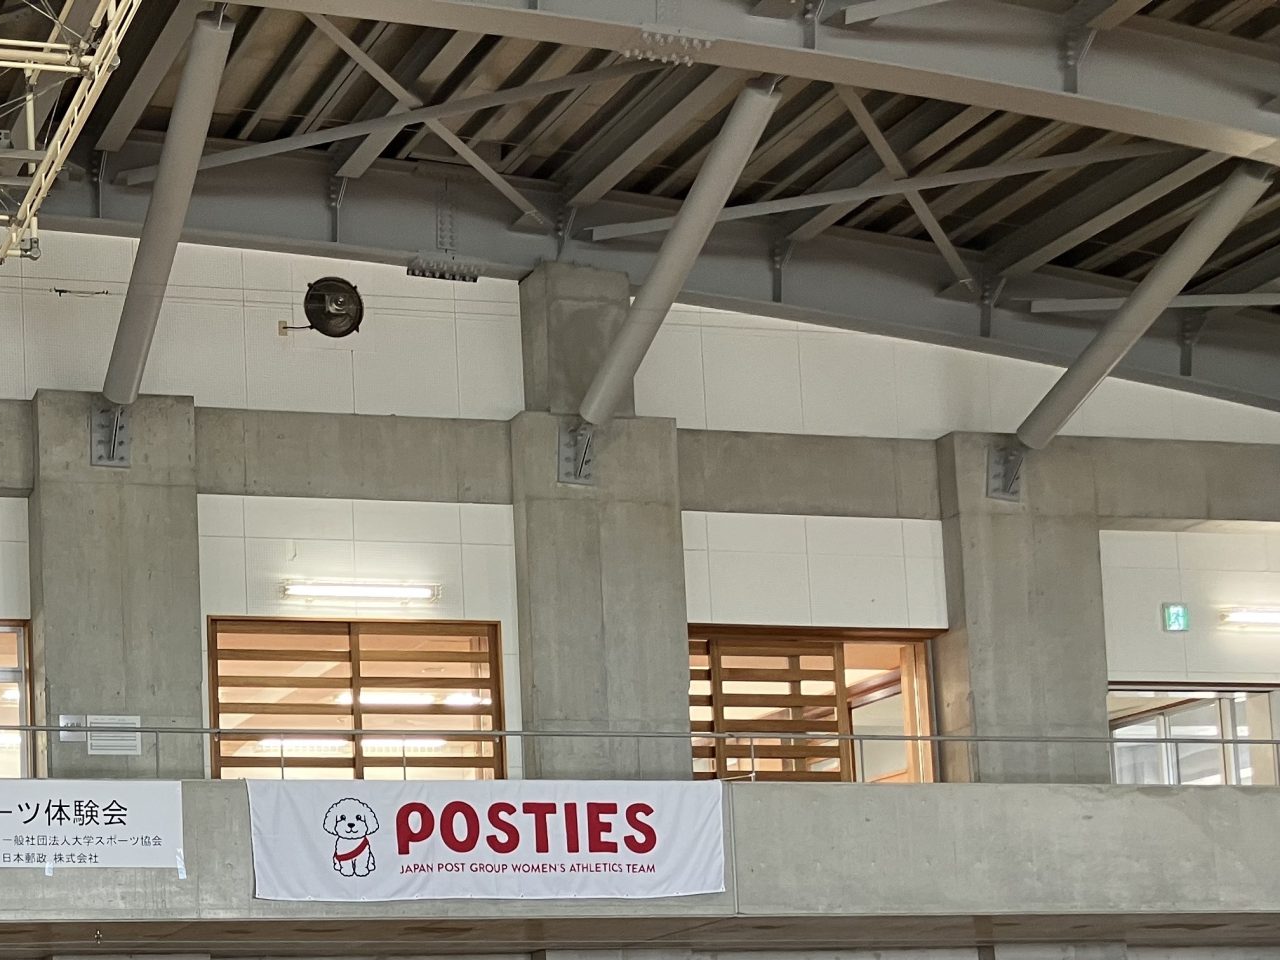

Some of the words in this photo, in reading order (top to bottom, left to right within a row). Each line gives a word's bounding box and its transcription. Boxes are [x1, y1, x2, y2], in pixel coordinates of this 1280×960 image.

[395, 800, 657, 855] POSTIES
[2, 834, 163, 847] 一般社団法人大学スポーツ協会
[2, 852, 47, 864] 日本郵政
[53, 852, 99, 864] 株式会社
[399, 863, 434, 875] JAPAN
[437, 863, 466, 873] POST
[469, 862, 508, 874] GROUP
[511, 862, 566, 874] WOMEN'S
[569, 862, 623, 874] ATHLETICS
[625, 863, 656, 874] TEAM
